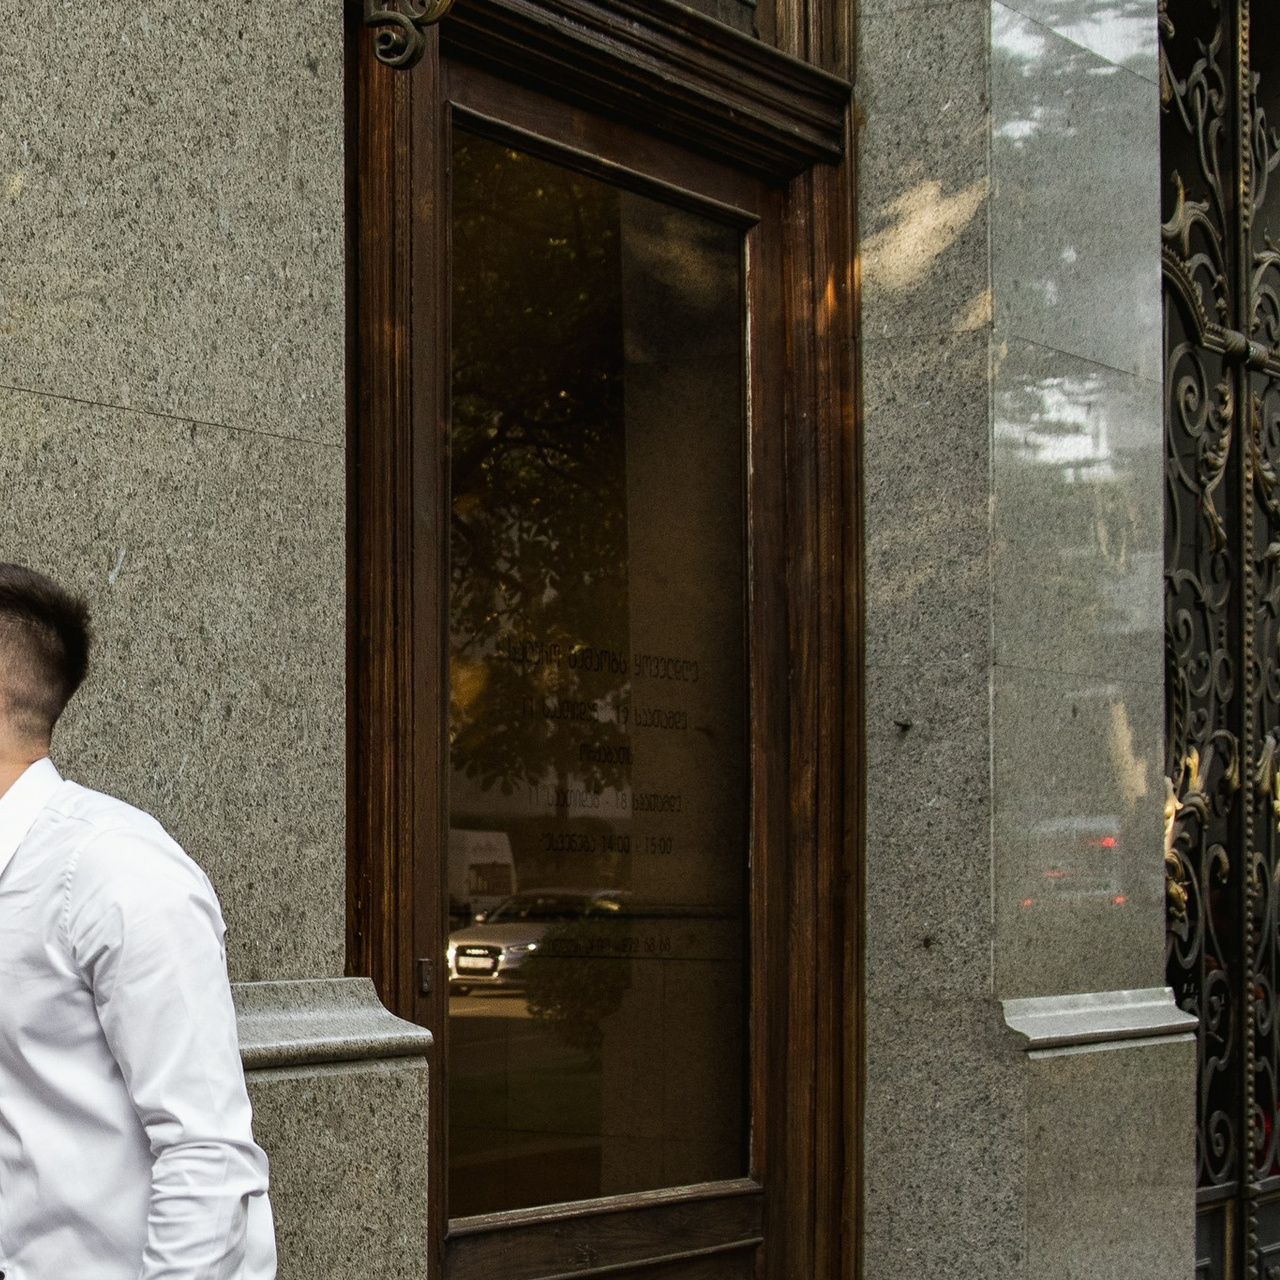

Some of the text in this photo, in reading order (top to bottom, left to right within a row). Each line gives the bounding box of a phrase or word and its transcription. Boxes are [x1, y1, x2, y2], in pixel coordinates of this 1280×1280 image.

[634, 653, 699, 683] ყოველდღე
[616, 704, 629, 724] 19
[615, 790, 627, 810] 18
